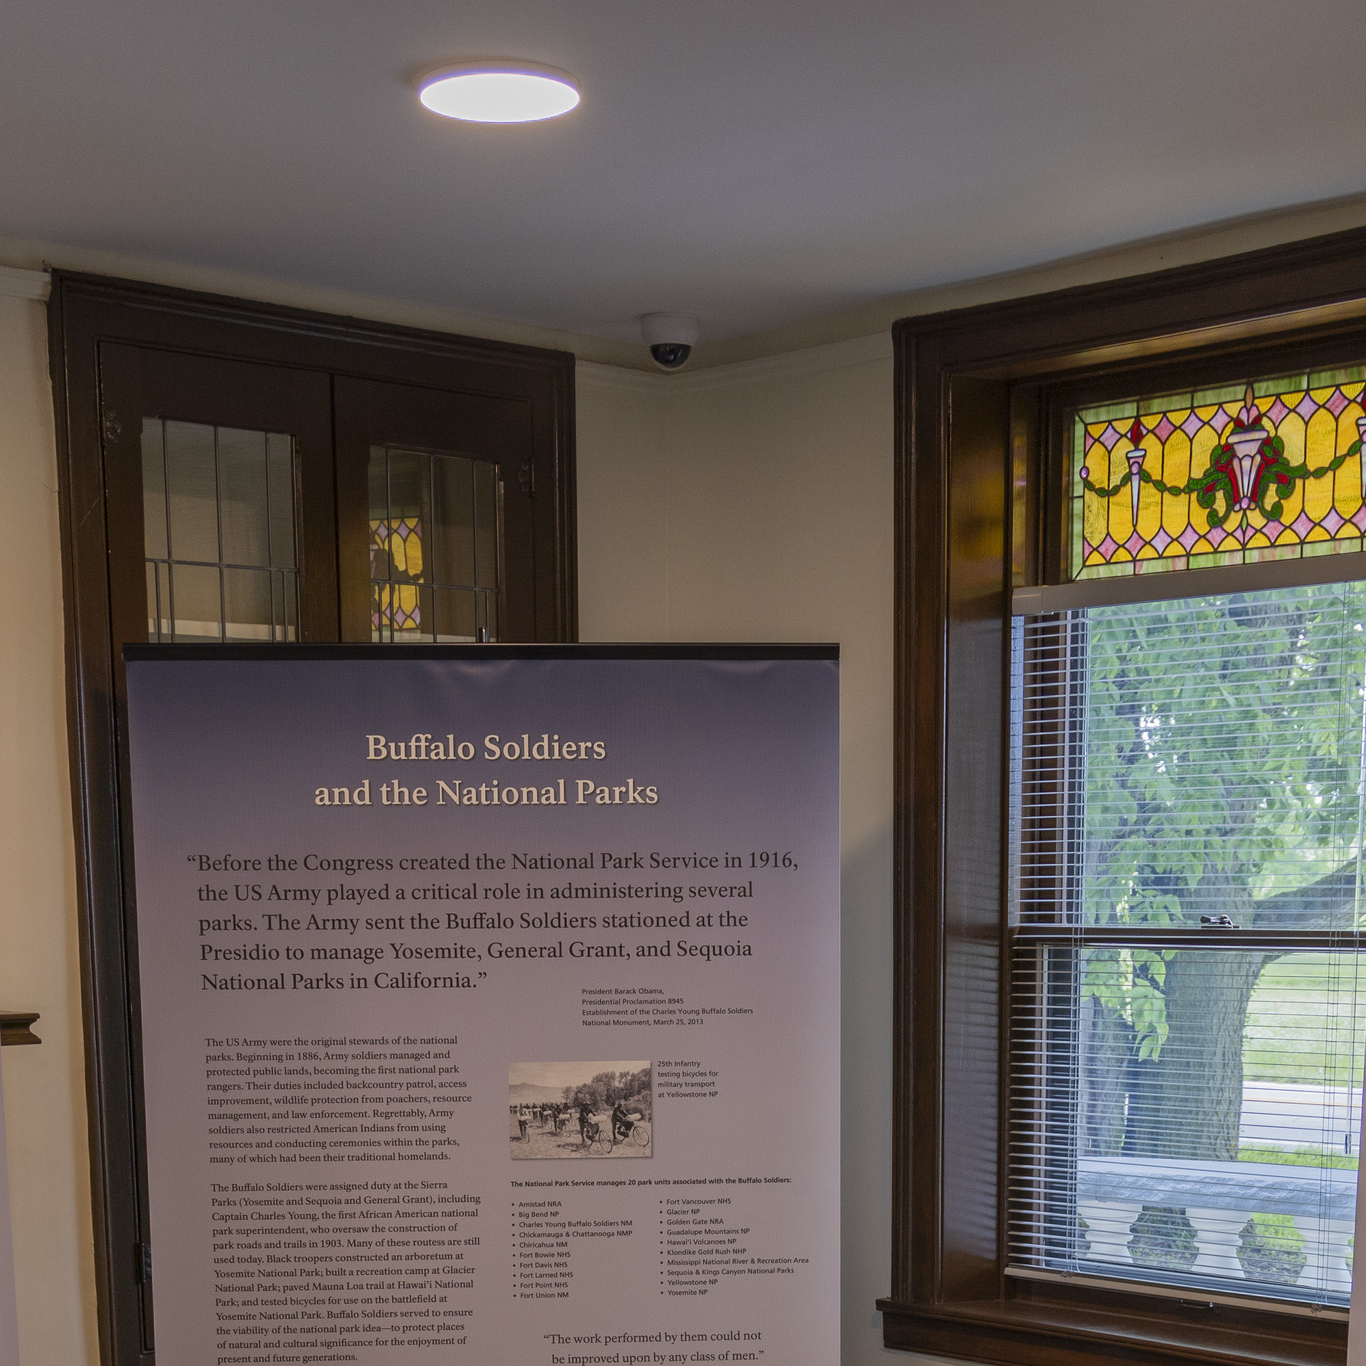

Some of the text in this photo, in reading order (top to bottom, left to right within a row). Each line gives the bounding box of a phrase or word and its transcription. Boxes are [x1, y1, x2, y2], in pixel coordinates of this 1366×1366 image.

[366, 734, 605, 760] Buffalo Soldiers
[315, 778, 657, 805] and the National Parks
[187, 852, 798, 876] “Before the Congress created the National Park Service in 1916,
[198, 881, 753, 906] the US Army played a critical role in administering several
[199, 910, 748, 936] parks. The Army sent the Buffalo Soldiers stationed at the
[201, 940, 752, 964] Presidio to manage Yosemite, General Grant, and Sequoia
[201, 972, 487, 990] National Parks in California.”
[517, 1200, 563, 1208] Amistad NRA
